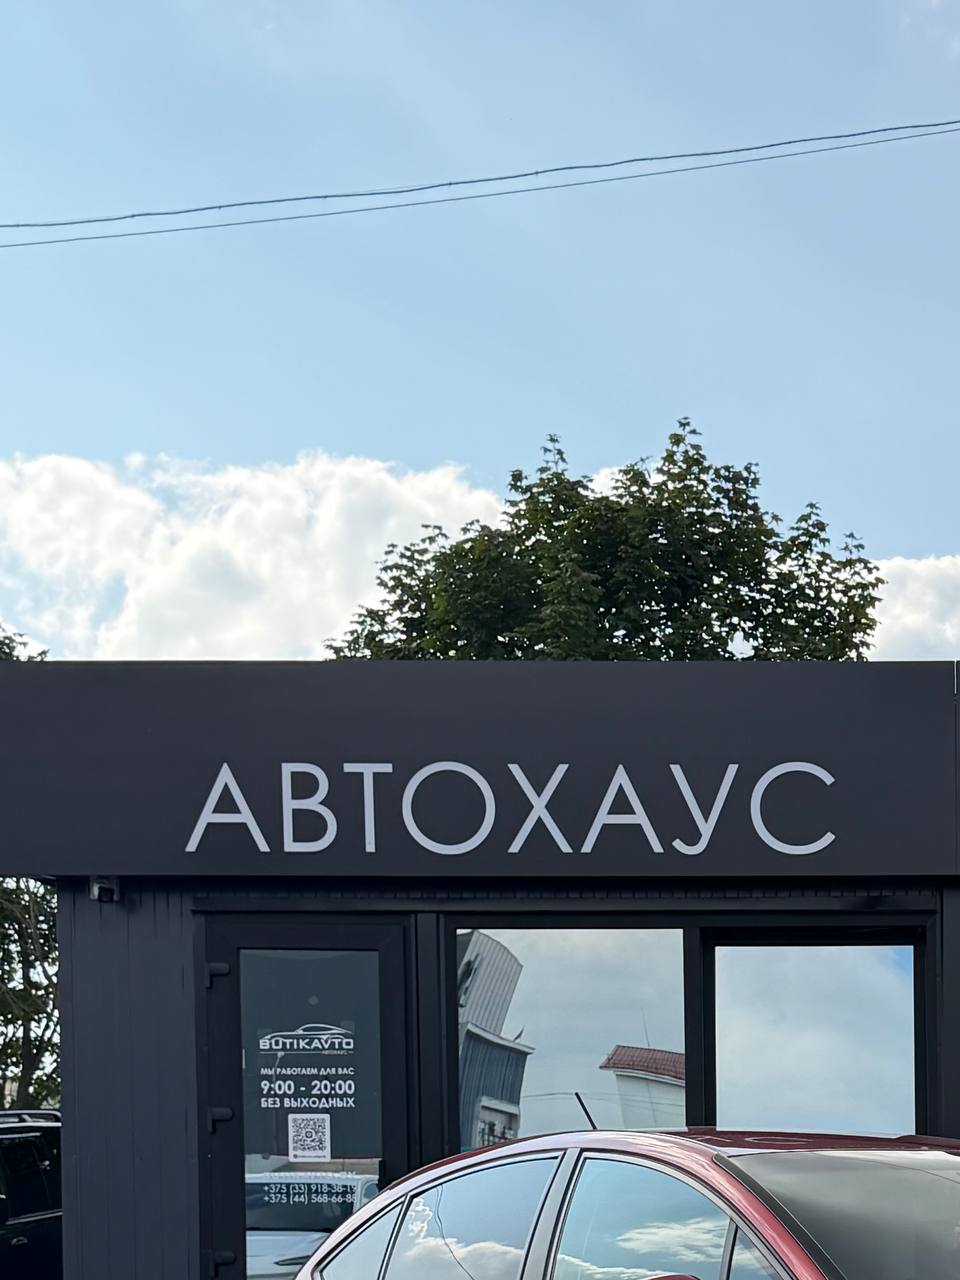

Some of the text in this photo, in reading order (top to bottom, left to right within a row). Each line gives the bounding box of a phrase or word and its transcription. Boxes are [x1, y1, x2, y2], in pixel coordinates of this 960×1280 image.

[185, 761, 836, 855] АВТОХАУС
[259, 1038, 354, 1050] BUTIKAVTO
[276, 1067, 318, 1075] РАБОТАЕМ
[320, 1067, 336, 1076] ДЛЯ
[338, 1067, 355, 1075] ВАС
[261, 1080, 295, 1095] 9:00
[311, 1080, 355, 1095] 20:00
[261, 1097, 356, 1109] БЕЗ ВЫХОДНЫХ
[264, 1184, 287, 1193] +375
[290, 1183, 308, 1195] (33)
[264, 1194, 287, 1203] +375
[290, 1193, 308, 1205] (44)
